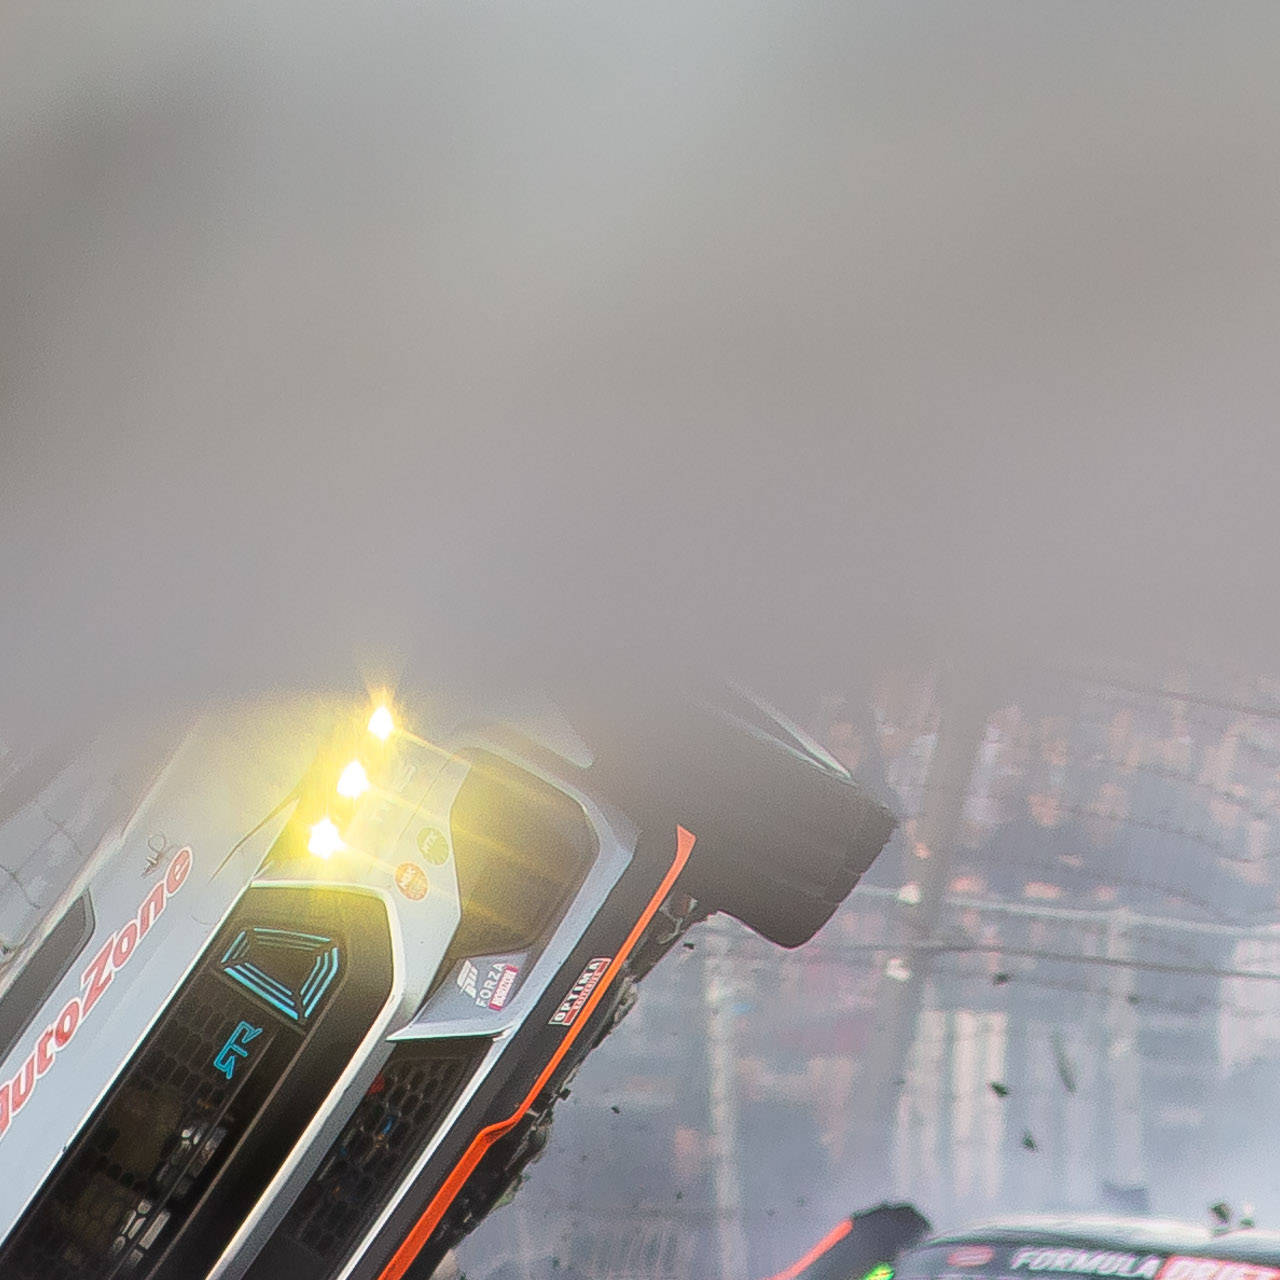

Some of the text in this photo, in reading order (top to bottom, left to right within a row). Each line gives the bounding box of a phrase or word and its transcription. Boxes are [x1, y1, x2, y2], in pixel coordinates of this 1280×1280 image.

[475, 963, 507, 1008] FORZA
[554, 961, 600, 1021] OPTIMA
[1010, 1247, 1166, 1280] FORMULA
